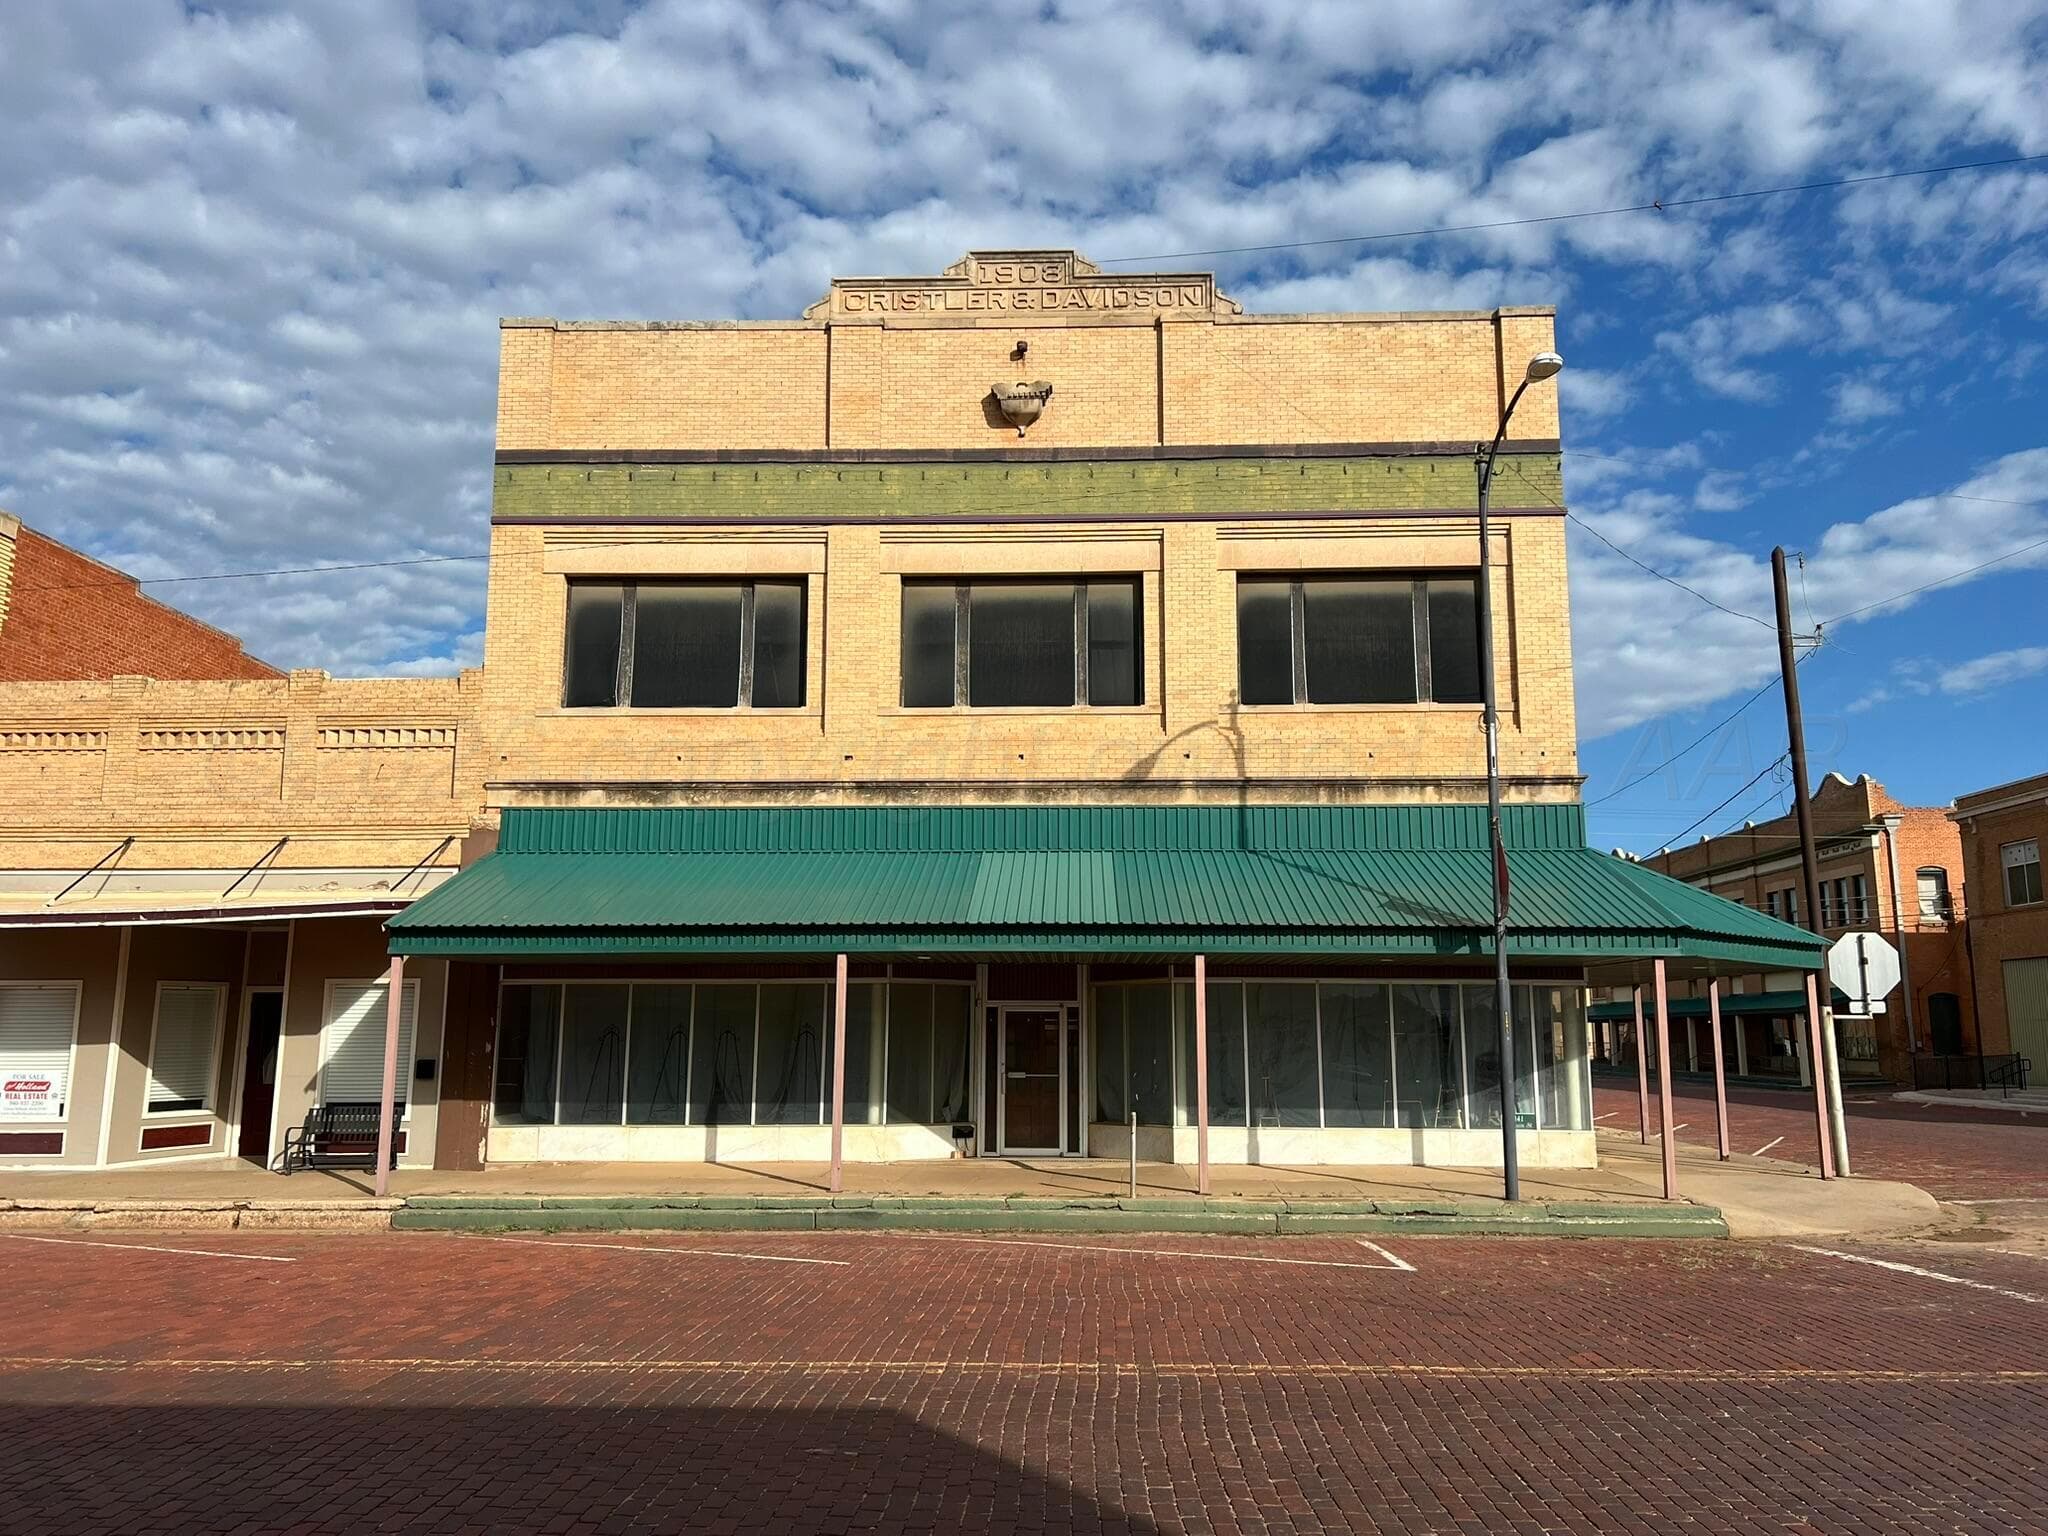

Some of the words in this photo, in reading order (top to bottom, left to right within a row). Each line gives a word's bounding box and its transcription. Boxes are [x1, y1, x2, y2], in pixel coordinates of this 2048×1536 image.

[979, 264, 1062, 284] 1908
[844, 289, 1007, 312] CRISTLER
[1012, 289, 1035, 310] &
[1040, 287, 1204, 310] DAVIDSON
